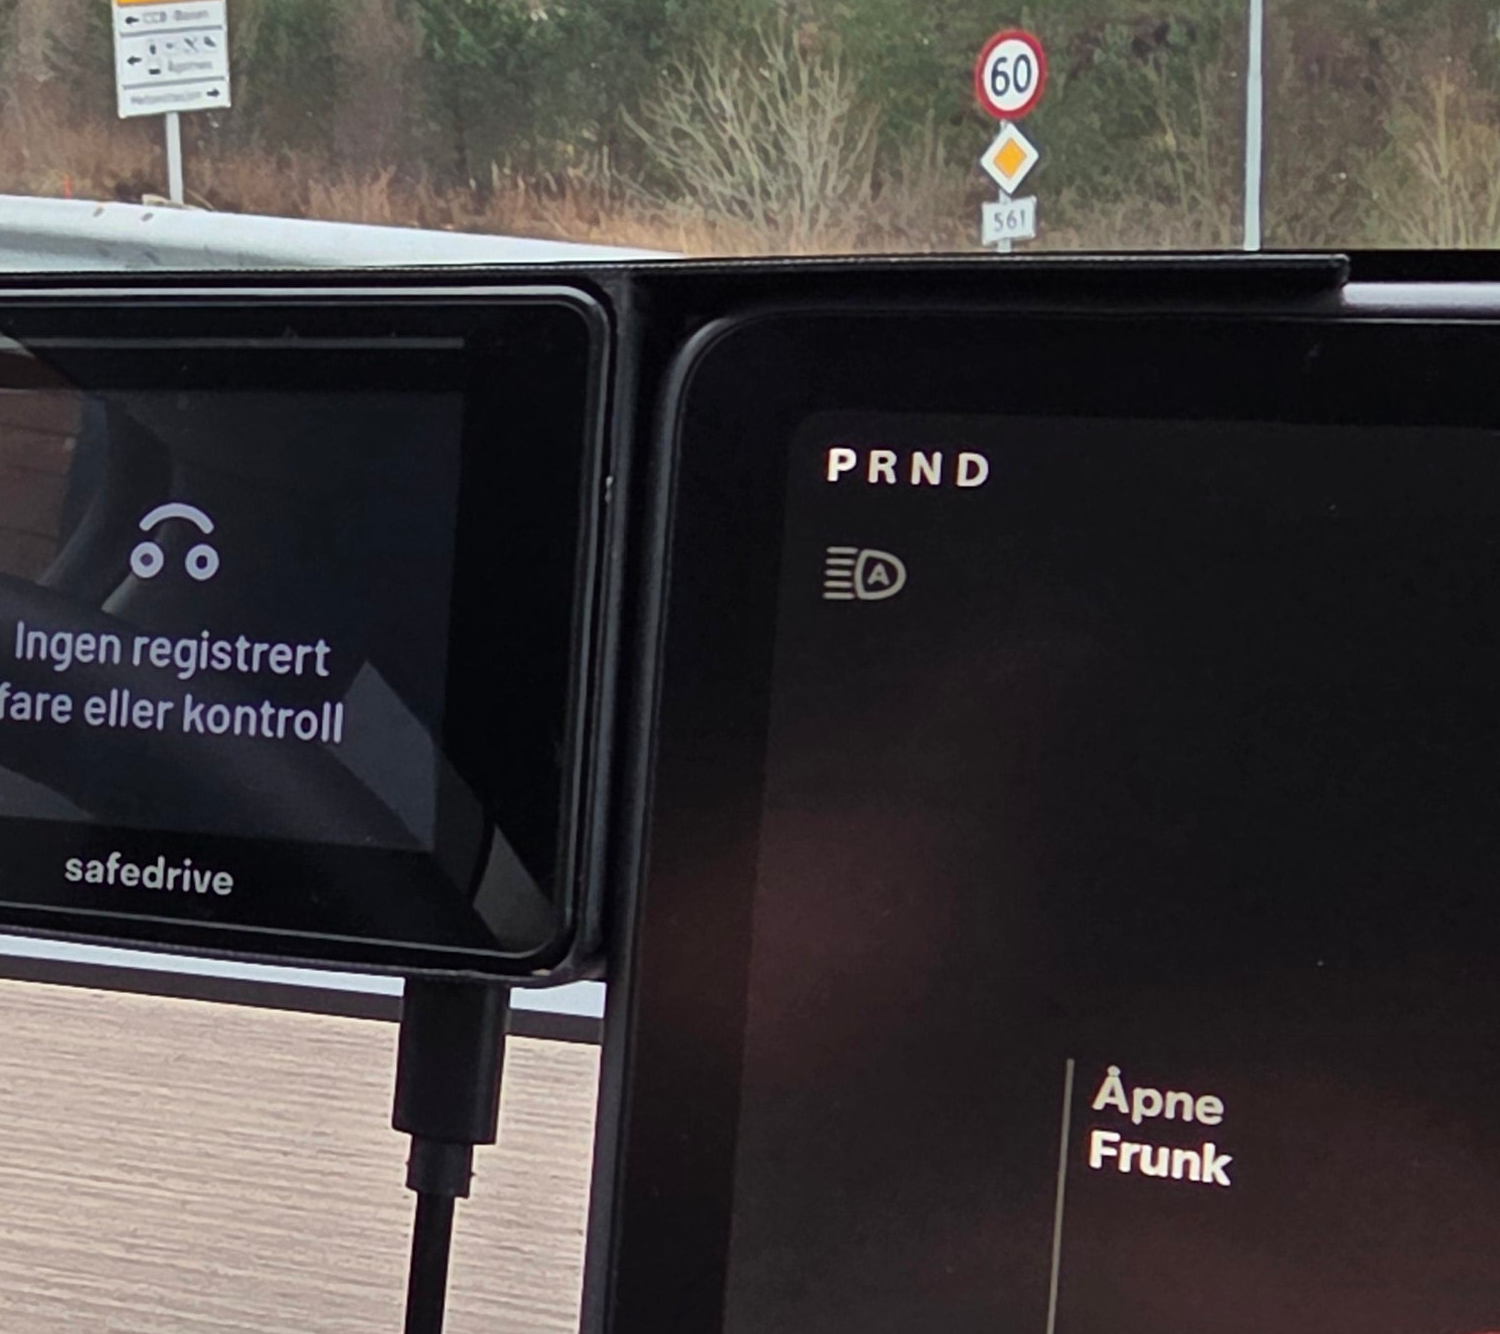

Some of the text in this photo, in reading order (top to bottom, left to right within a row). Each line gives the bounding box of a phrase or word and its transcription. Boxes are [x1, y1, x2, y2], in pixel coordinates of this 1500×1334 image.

[991, 53, 1032, 97] 60
[993, 209, 1026, 232] 561
[15, 620, 331, 680] Ingen registrert
[84, 688, 174, 731] eller
[182, 693, 344, 744] kontroll
[65, 851, 234, 896] safedrive
[1092, 1065, 1225, 1125] Åpne
[1089, 1129, 1233, 1186] Frunk
